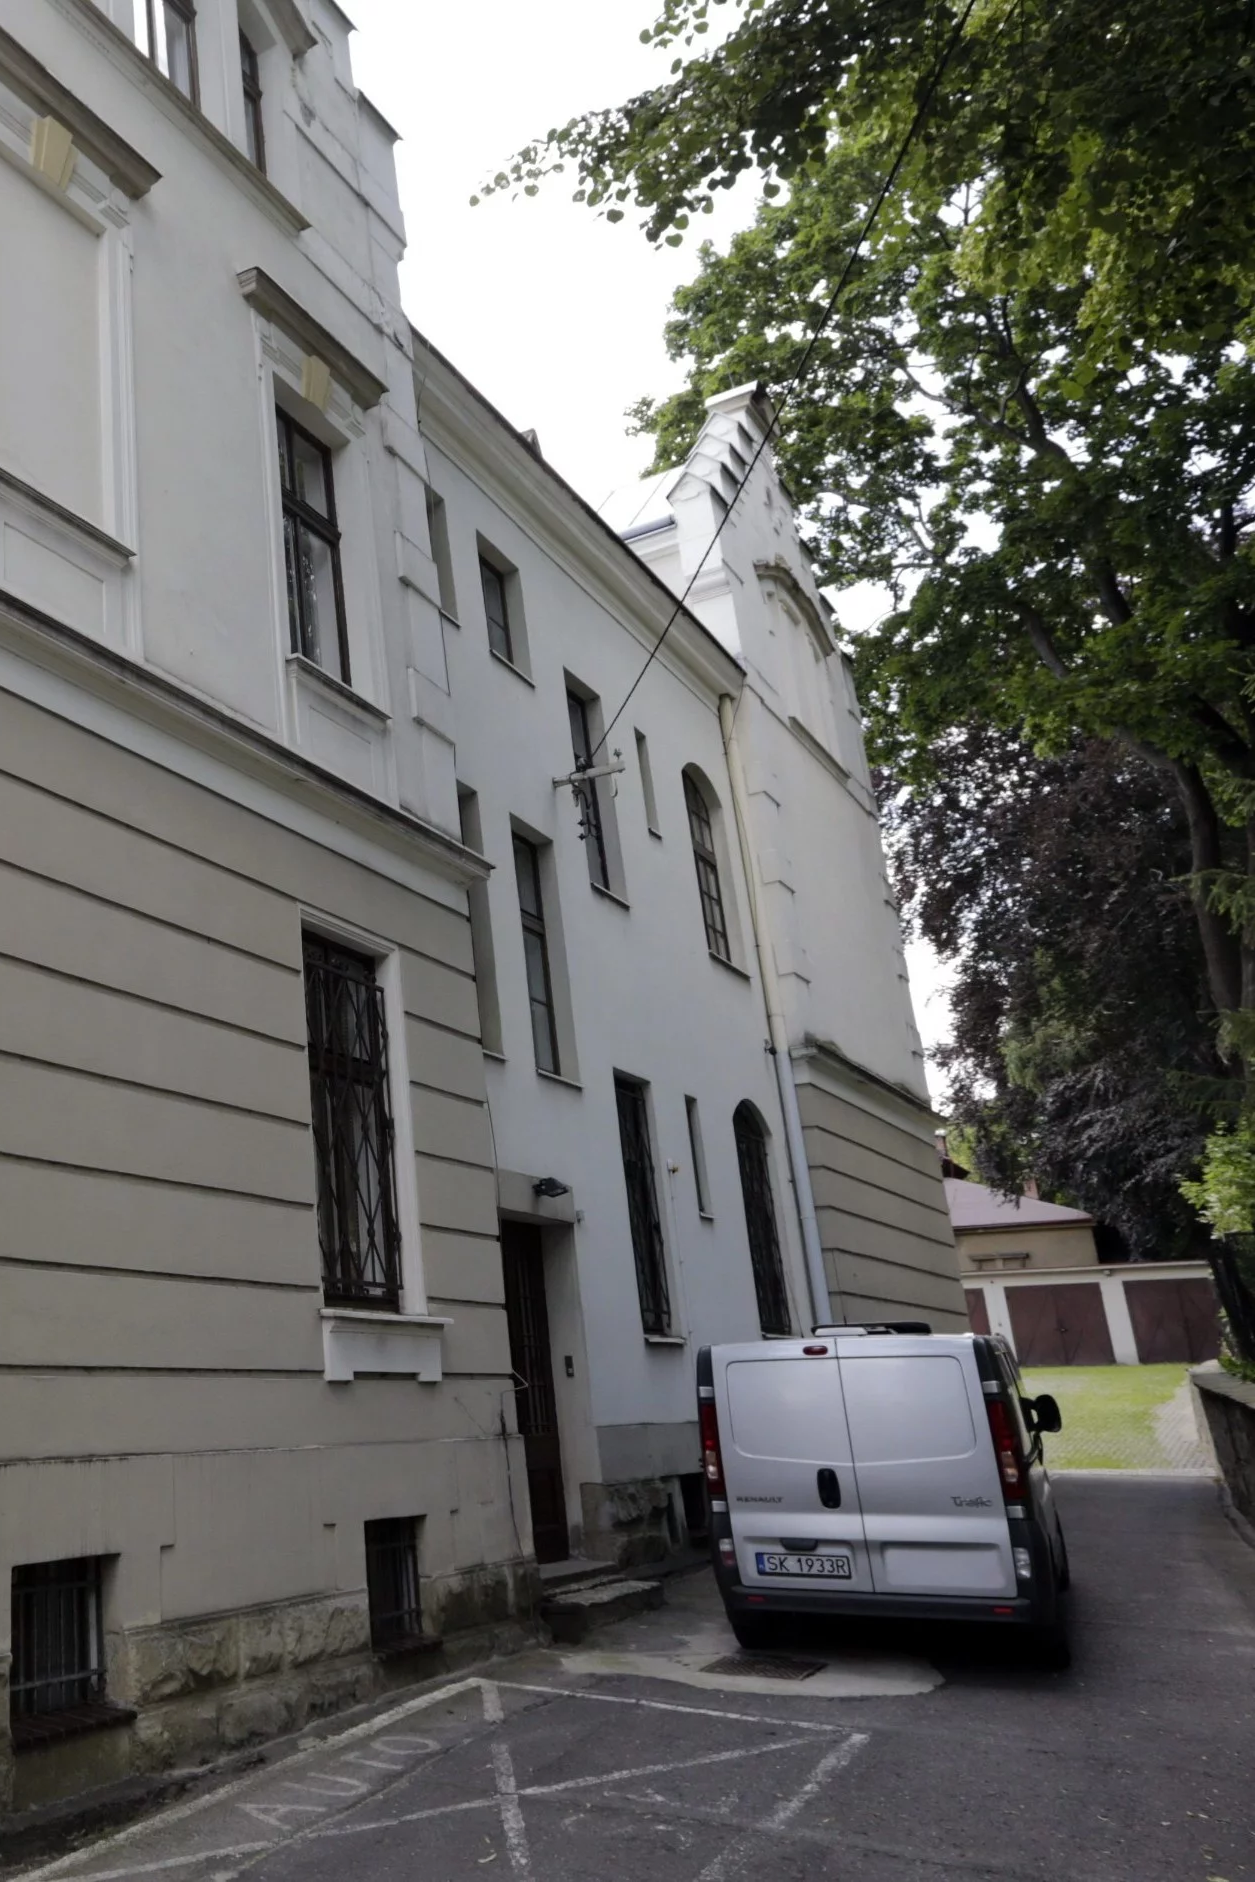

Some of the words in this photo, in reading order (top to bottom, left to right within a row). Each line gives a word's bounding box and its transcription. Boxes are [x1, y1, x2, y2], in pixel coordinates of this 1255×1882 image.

[735, 1496, 784, 1504] RENAULT
[766, 1556, 789, 1572] SK
[797, 1557, 847, 1574] 1933R
[234, 1735, 442, 1831] AUTO
